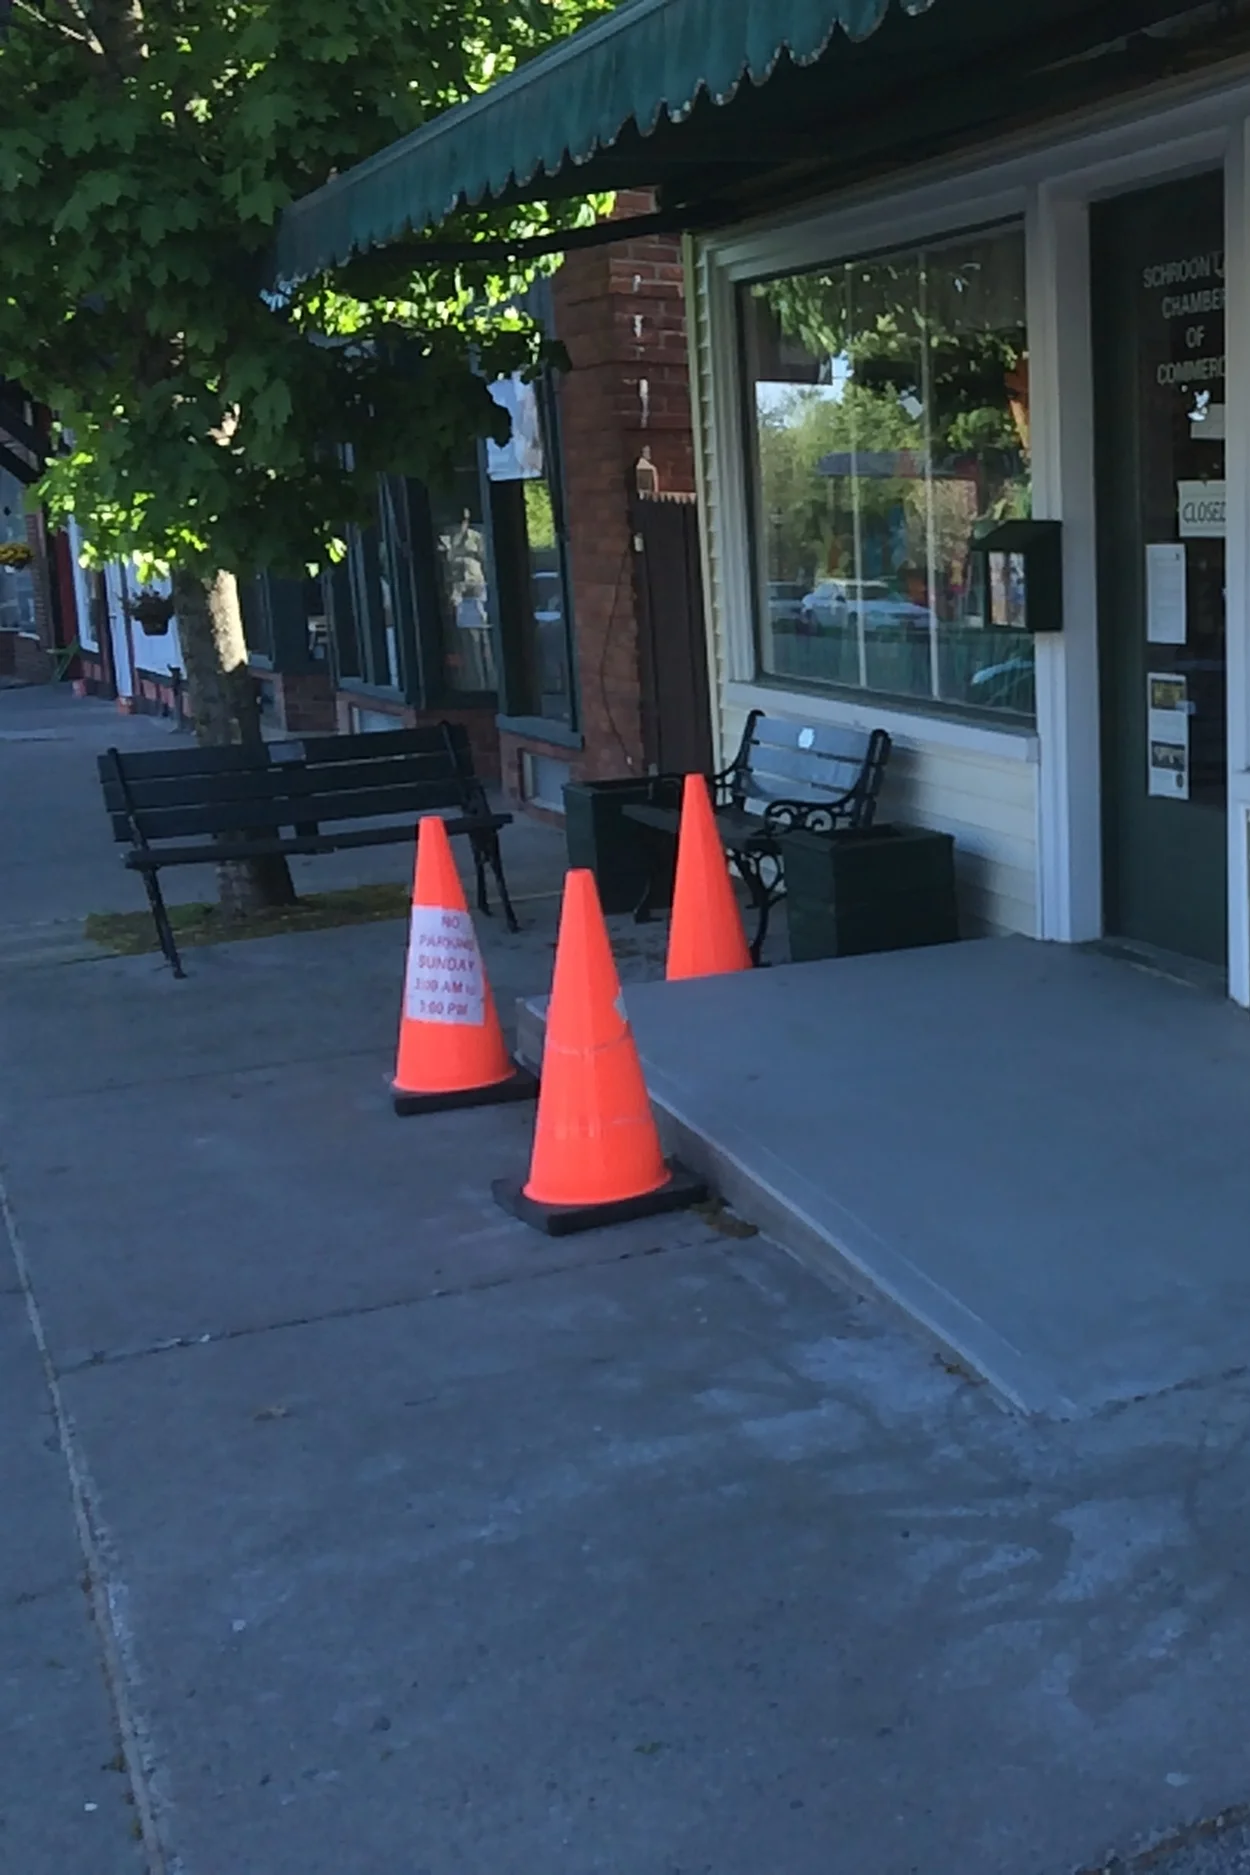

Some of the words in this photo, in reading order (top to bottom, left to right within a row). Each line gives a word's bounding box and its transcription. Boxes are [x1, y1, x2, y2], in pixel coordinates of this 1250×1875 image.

[1143, 255, 1211, 288] SCHROON
[1186, 326, 1205, 348] OF
[1157, 356, 1226, 385] COMMERC
[442, 916, 460, 929] NO
[419, 934, 475, 951] PARKING
[418, 955, 475, 971] SUNDAY
[442, 981, 463, 994] AM
[447, 1002, 469, 1016] PM
